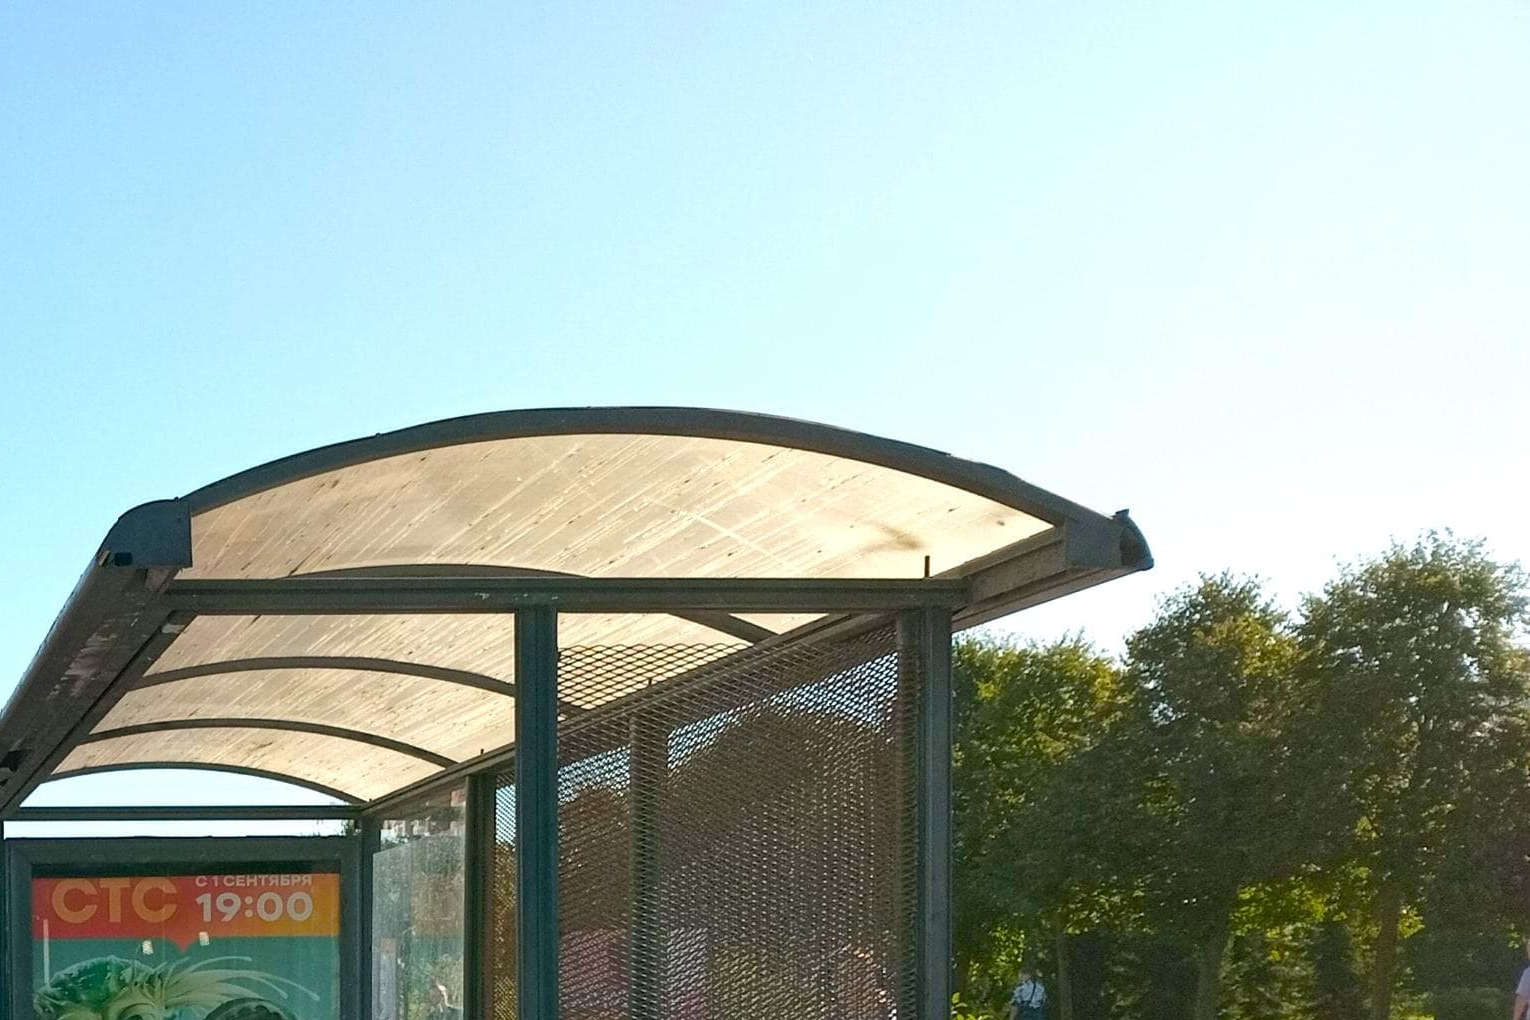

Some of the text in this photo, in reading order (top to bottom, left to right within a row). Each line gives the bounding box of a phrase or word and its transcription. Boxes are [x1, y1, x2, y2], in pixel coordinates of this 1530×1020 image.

[195, 874, 312, 887] С 1 СЕНТЯБРЯ
[51, 878, 178, 923] СТС
[195, 891, 313, 922] 19:00
